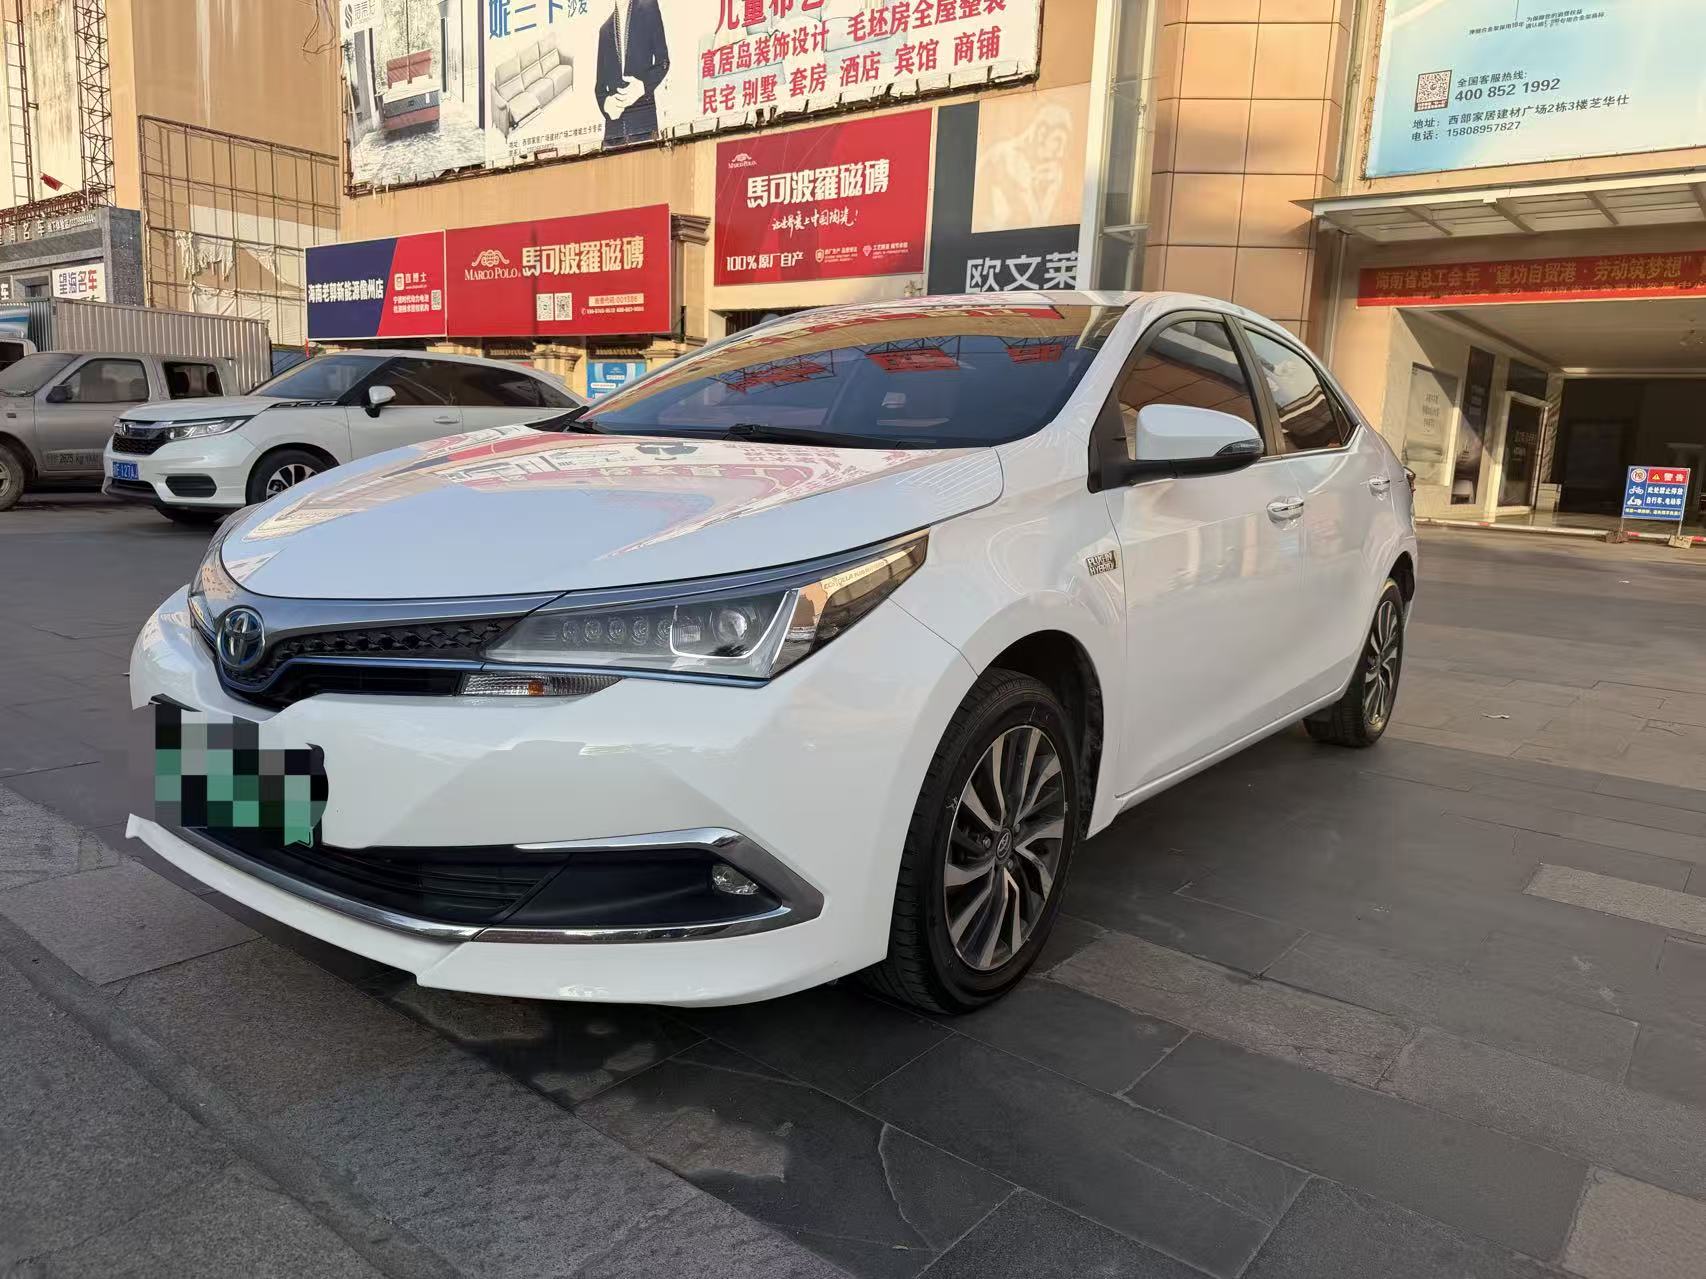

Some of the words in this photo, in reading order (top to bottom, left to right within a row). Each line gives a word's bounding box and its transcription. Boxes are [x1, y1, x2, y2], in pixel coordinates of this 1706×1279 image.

[714, 0, 825, 35] 儿童
[701, 20, 829, 79] 富居岛装饰设计
[702, 82, 737, 116] 民宅
[741, 73, 778, 108] 别墅
[789, 62, 828, 99] 套房
[840, 51, 881, 88] 酒店
[894, 38, 940, 77] 宾馆
[953, 25, 1002, 66] 商铺
[1455, 88, 1483, 102] 400
[1487, 84, 1517, 98] 852
[1522, 78, 1561, 94] 1992
[1447, 121, 1521, 137] 15808957827
[747, 158, 889, 209] 馬可波羅磁磚
[464, 269, 494, 281] MARCO
[495, 267, 518, 279] POLO
[522, 236, 644, 277] 馬可波羅磁磚
[965, 251, 1078, 293] 欧文莱
